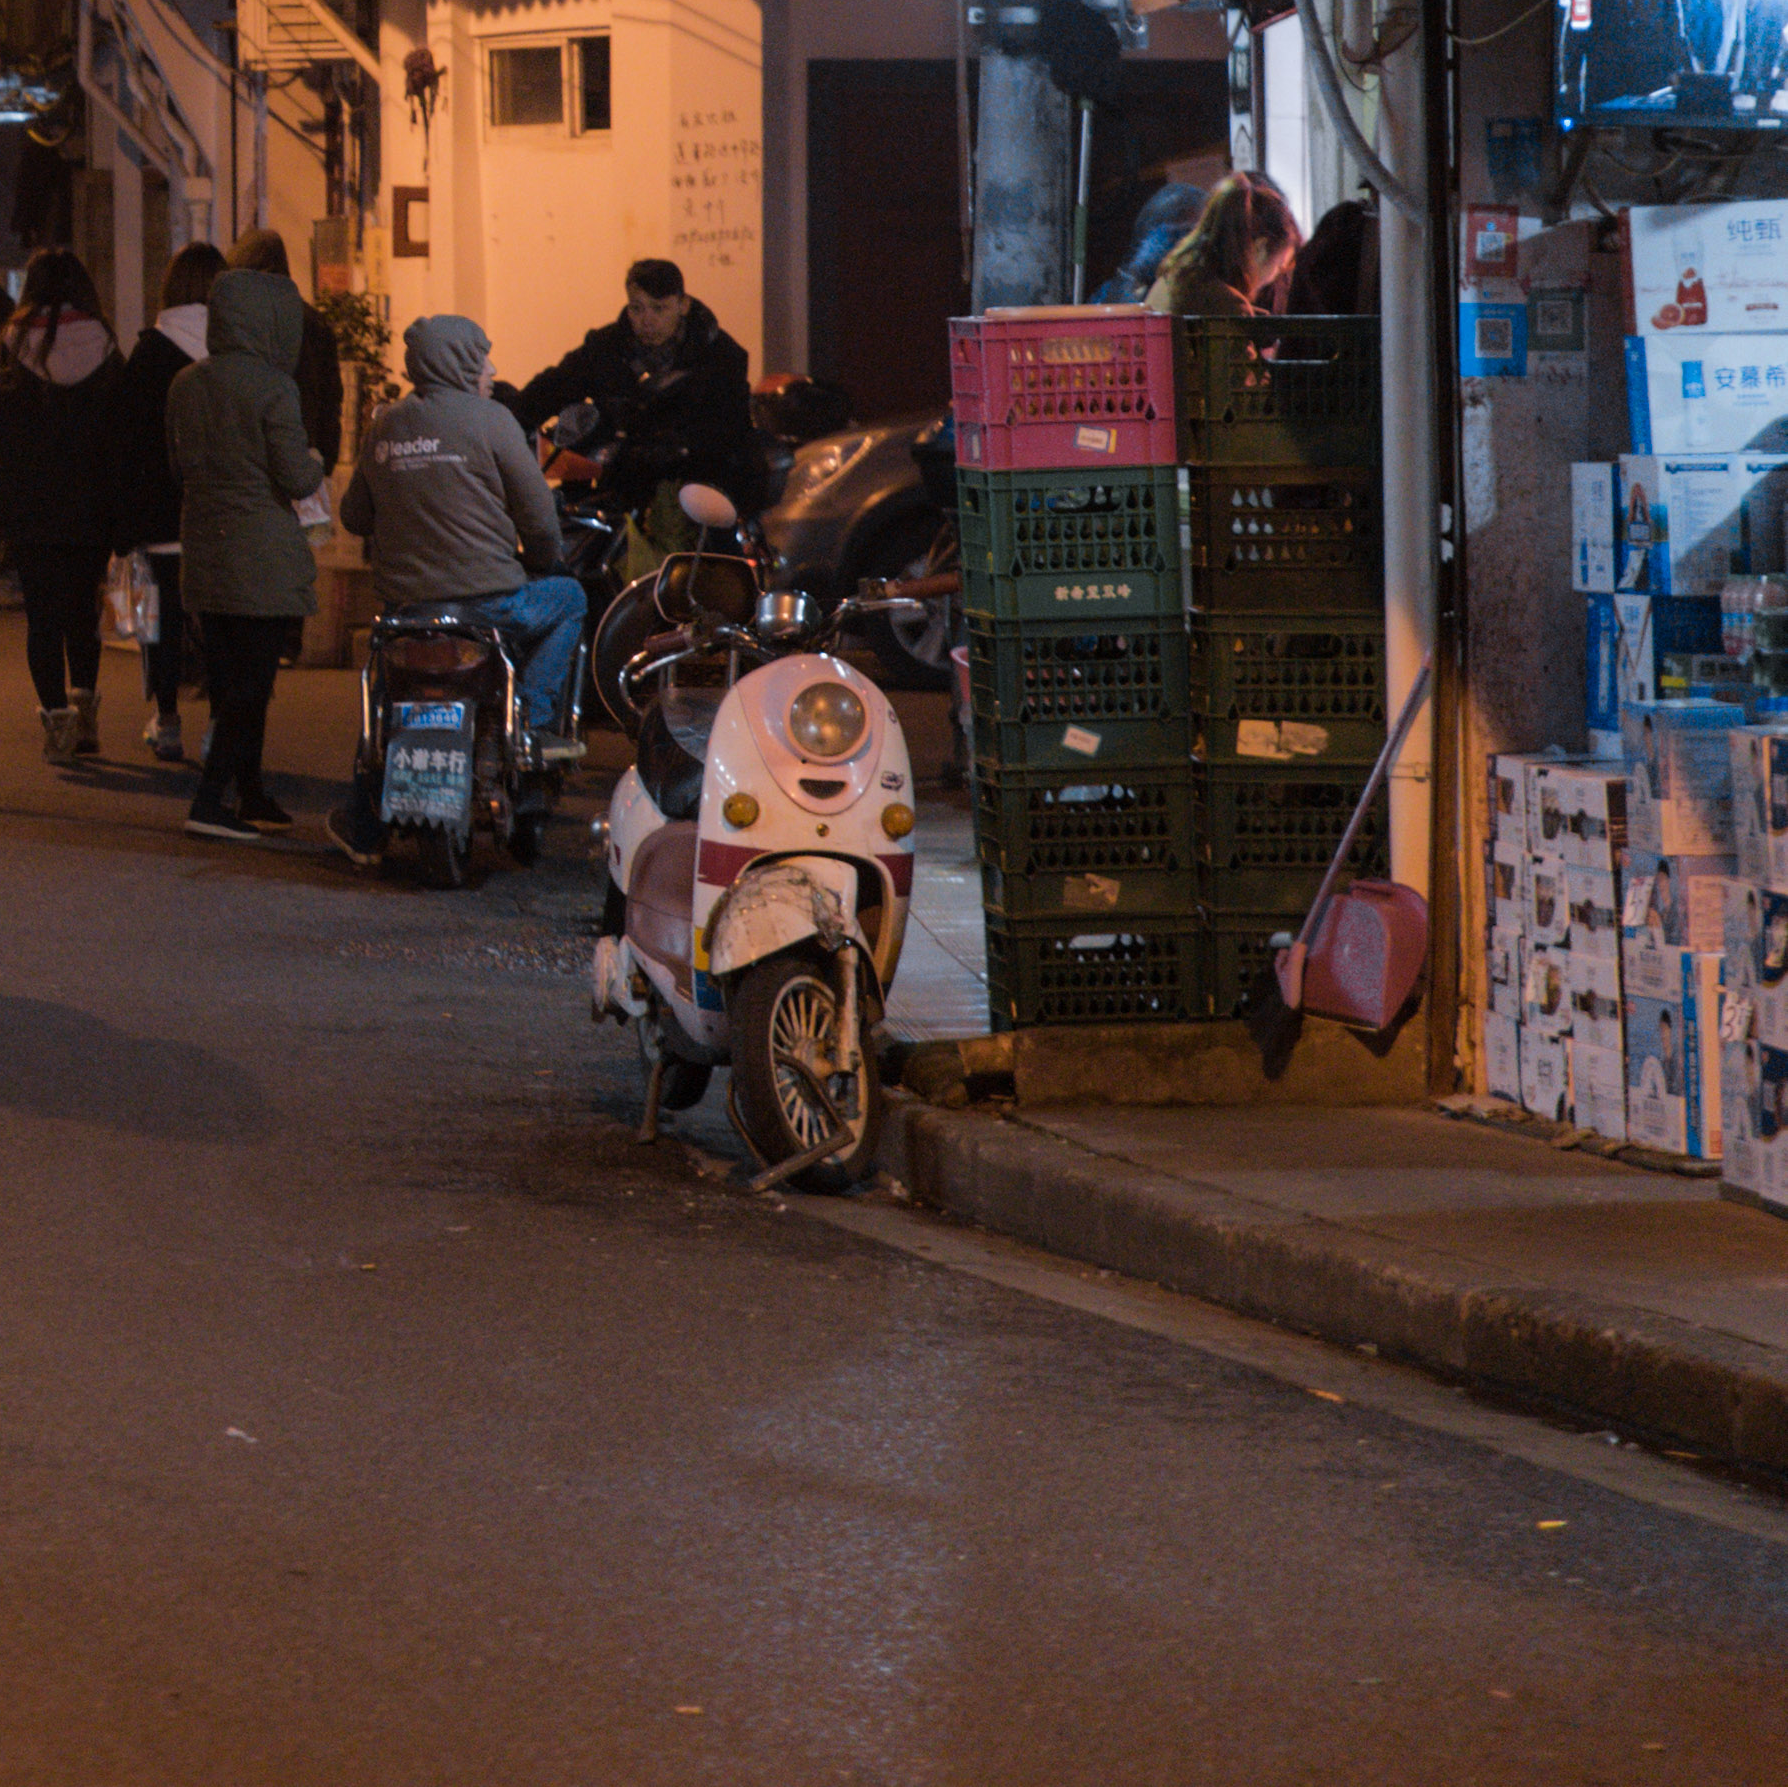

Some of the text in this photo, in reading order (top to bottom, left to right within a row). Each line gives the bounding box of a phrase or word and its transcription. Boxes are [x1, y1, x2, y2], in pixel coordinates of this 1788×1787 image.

[1726, 218, 1782, 242] 纯甄
[1714, 363, 1788, 391] 安慕希
[389, 436, 440, 458] leader
